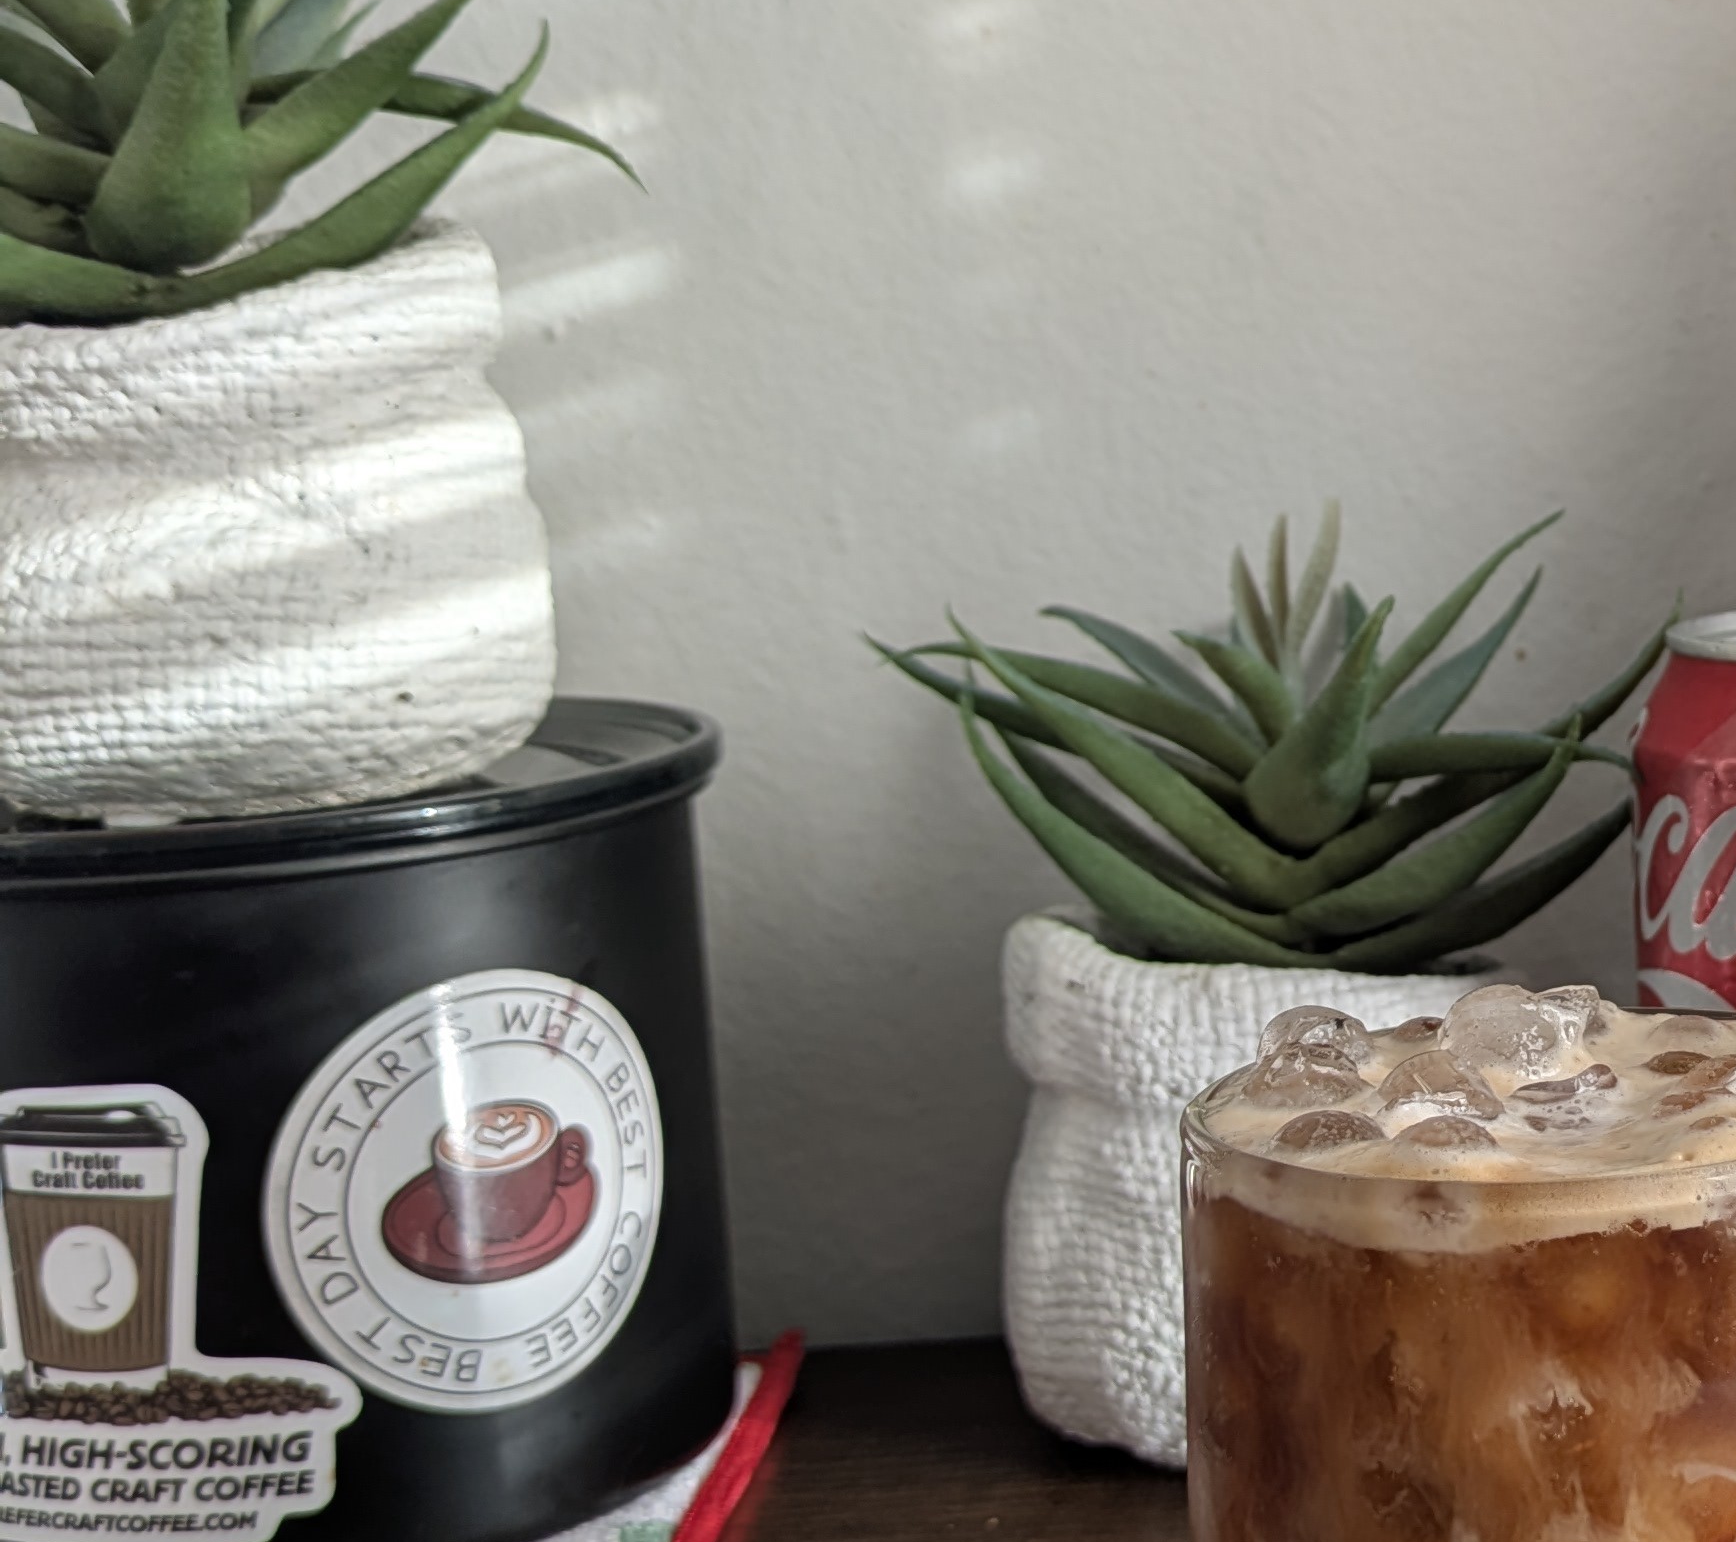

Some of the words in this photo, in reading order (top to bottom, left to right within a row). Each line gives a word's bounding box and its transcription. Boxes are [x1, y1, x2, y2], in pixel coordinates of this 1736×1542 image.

[312, 1011, 473, 1172] STARTS
[605, 1060, 648, 1180] BEST
[82, 1170, 146, 1190] Coffee
[297, 1202, 360, 1307] DAY
[525, 1210, 643, 1370] COFFEE
[355, 1316, 484, 1383] BEST
[21, 1431, 314, 1469] HIGH-SCORING
[89, 1477, 188, 1503] CRAFT
[194, 1469, 317, 1501] COFFEE
